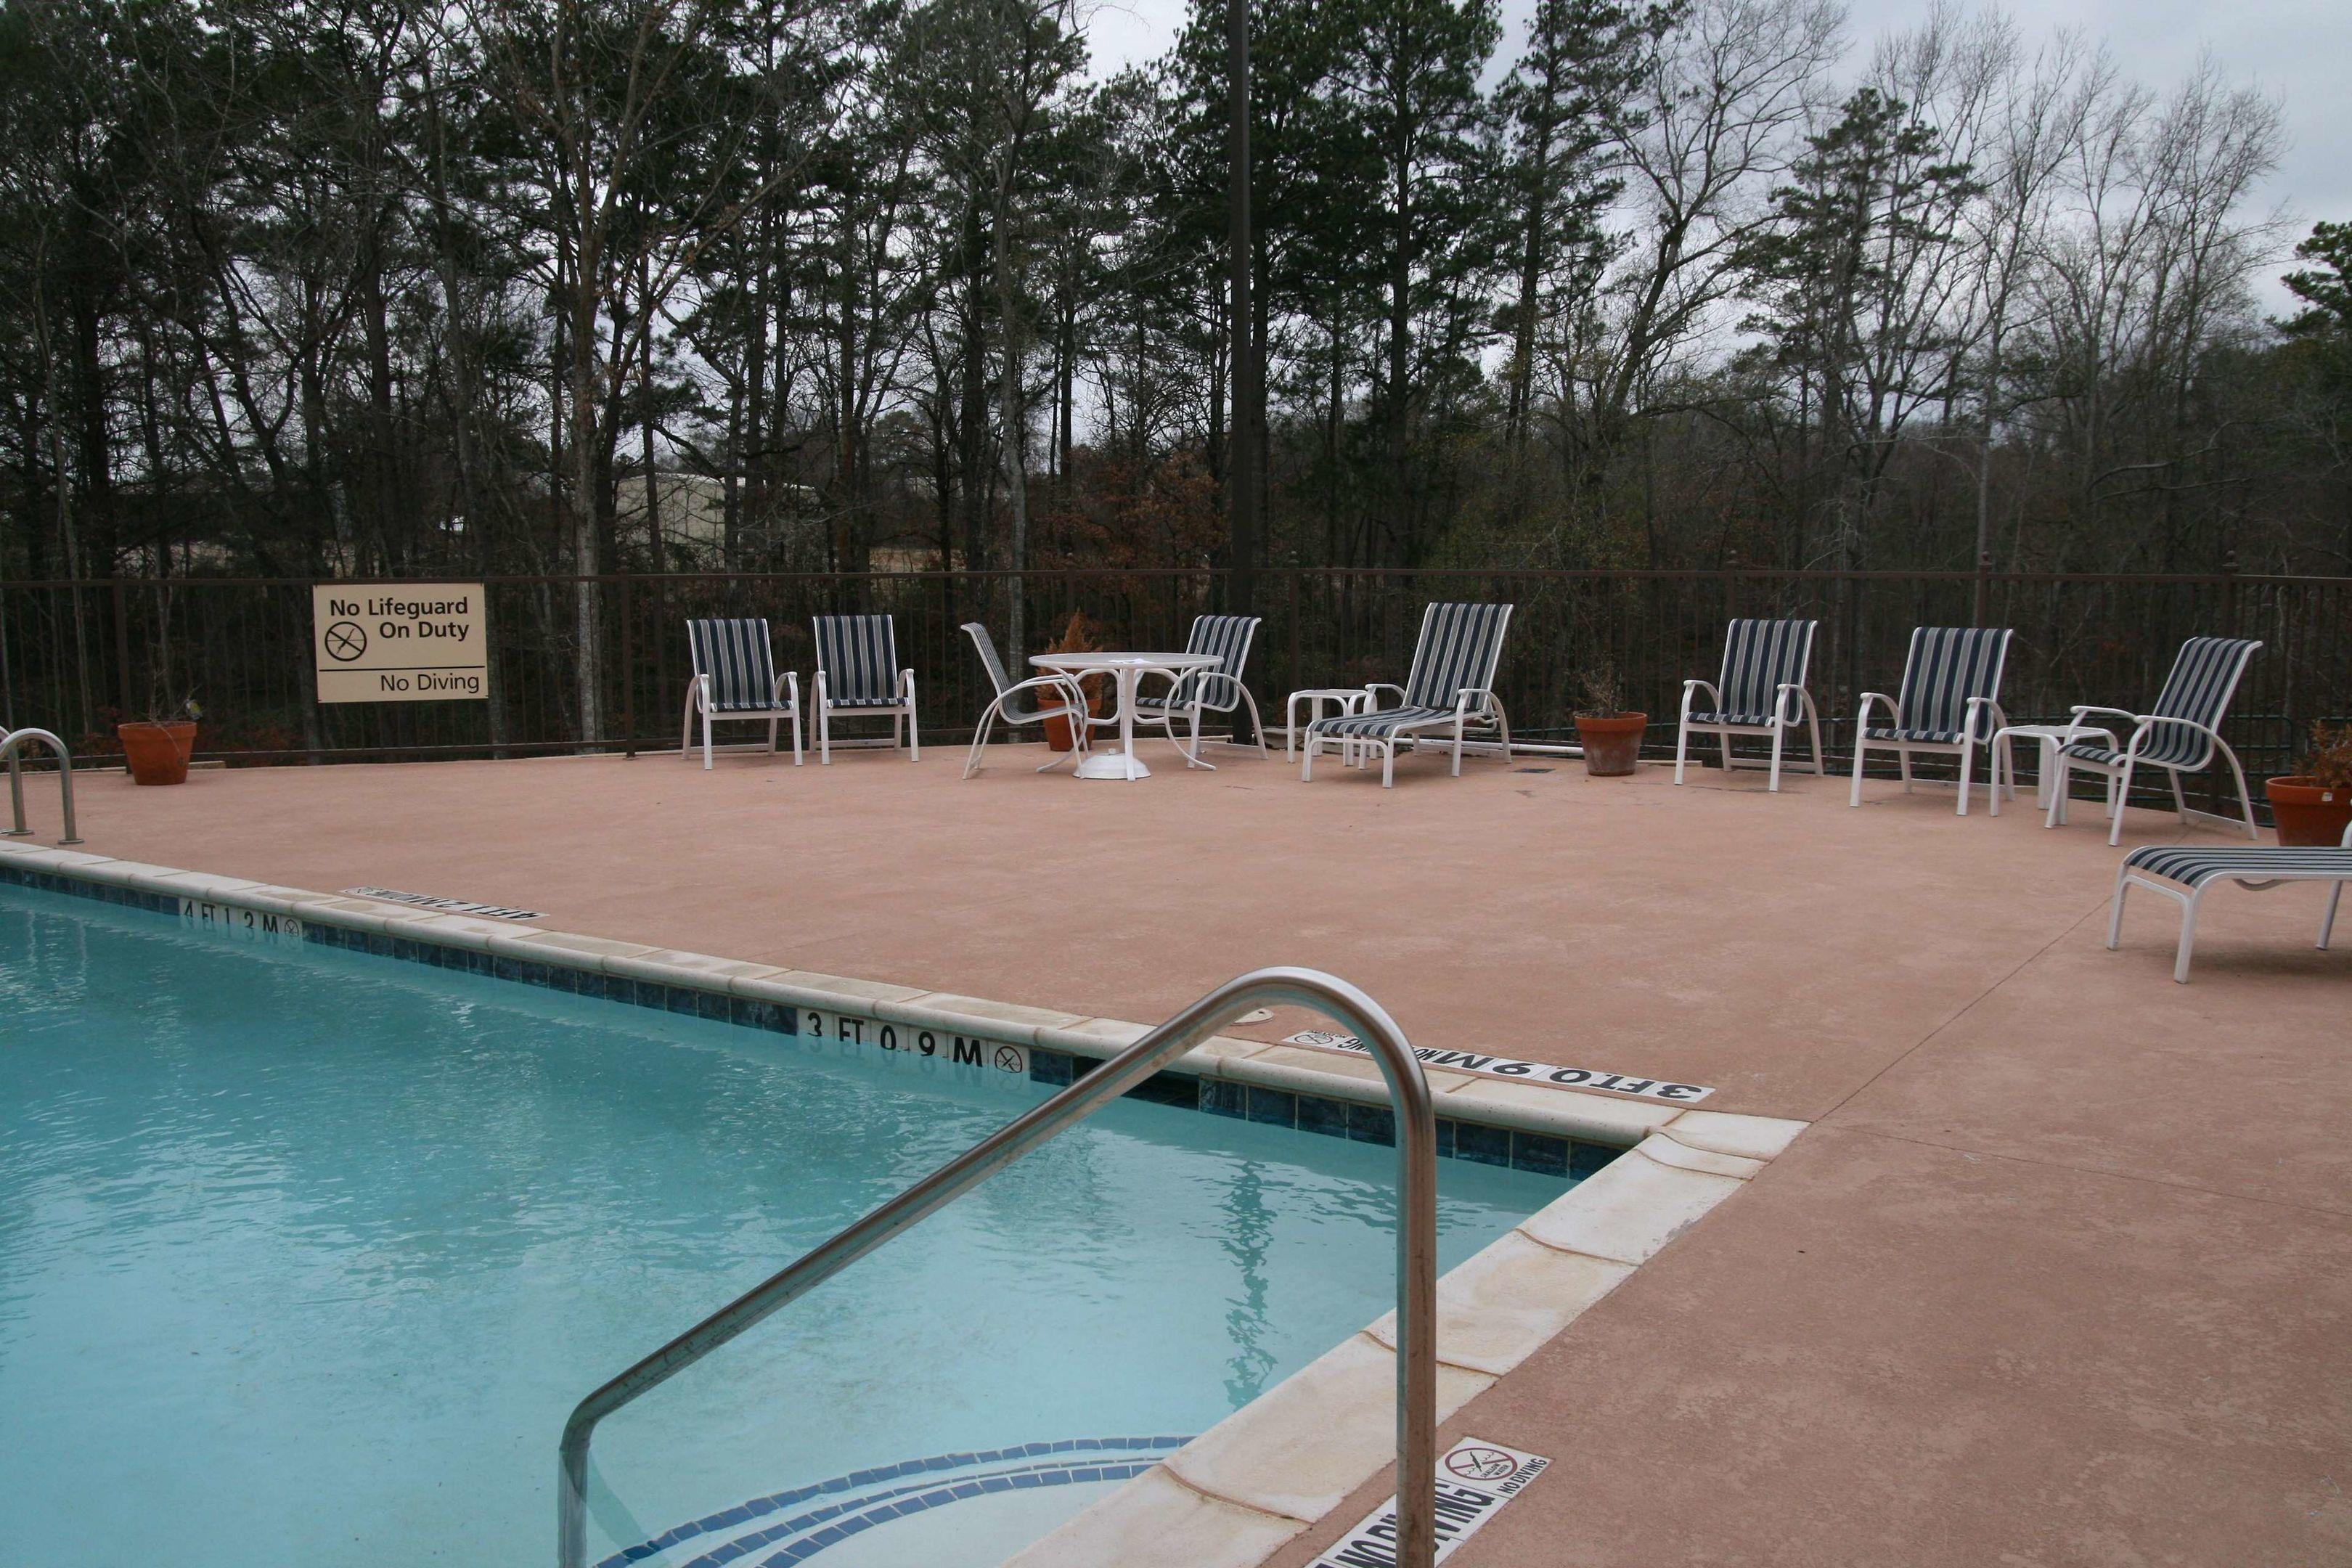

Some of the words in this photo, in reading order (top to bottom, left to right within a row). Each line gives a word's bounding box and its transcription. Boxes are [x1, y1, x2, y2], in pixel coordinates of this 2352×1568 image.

[330, 599, 360, 616] No
[368, 597, 468, 619] Lifeguard
[379, 621, 410, 638] On
[418, 621, 470, 642] Duty
[380, 674, 409, 691] No
[417, 673, 480, 693] Diving
[838, 1016, 865, 1045] FT
[1496, 1481, 1521, 1495] NO
[1512, 1458, 1548, 1484] DIVING
